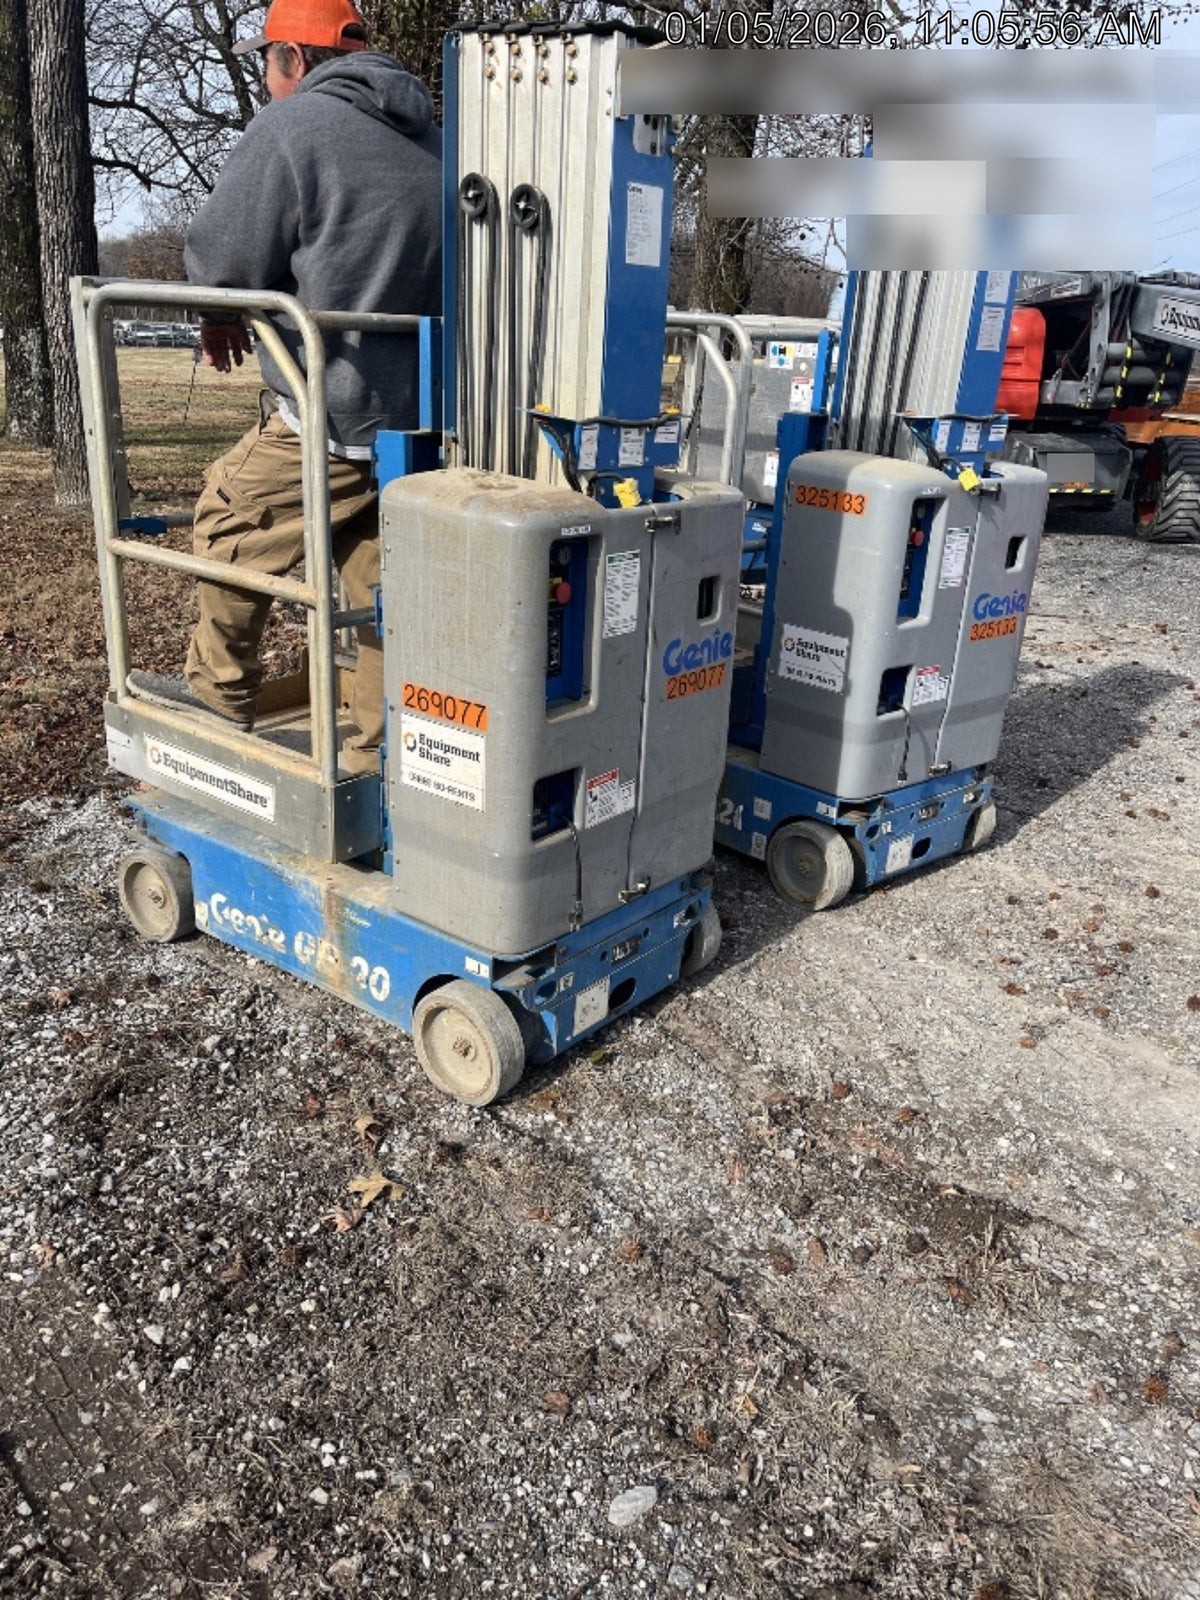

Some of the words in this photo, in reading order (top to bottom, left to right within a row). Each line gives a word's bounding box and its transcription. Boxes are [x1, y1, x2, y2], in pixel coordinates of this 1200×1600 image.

[795, 484, 866, 515] 325133
[973, 588, 1027, 620] Genie
[970, 616, 1017, 641] 325133
[663, 627, 734, 667] Genie
[666, 663, 727, 699] 269077
[404, 683, 487, 728] 269077
[418, 732, 482, 763] Equipment
[418, 747, 451, 767] Share
[162, 751, 269, 808] EquipmentShare
